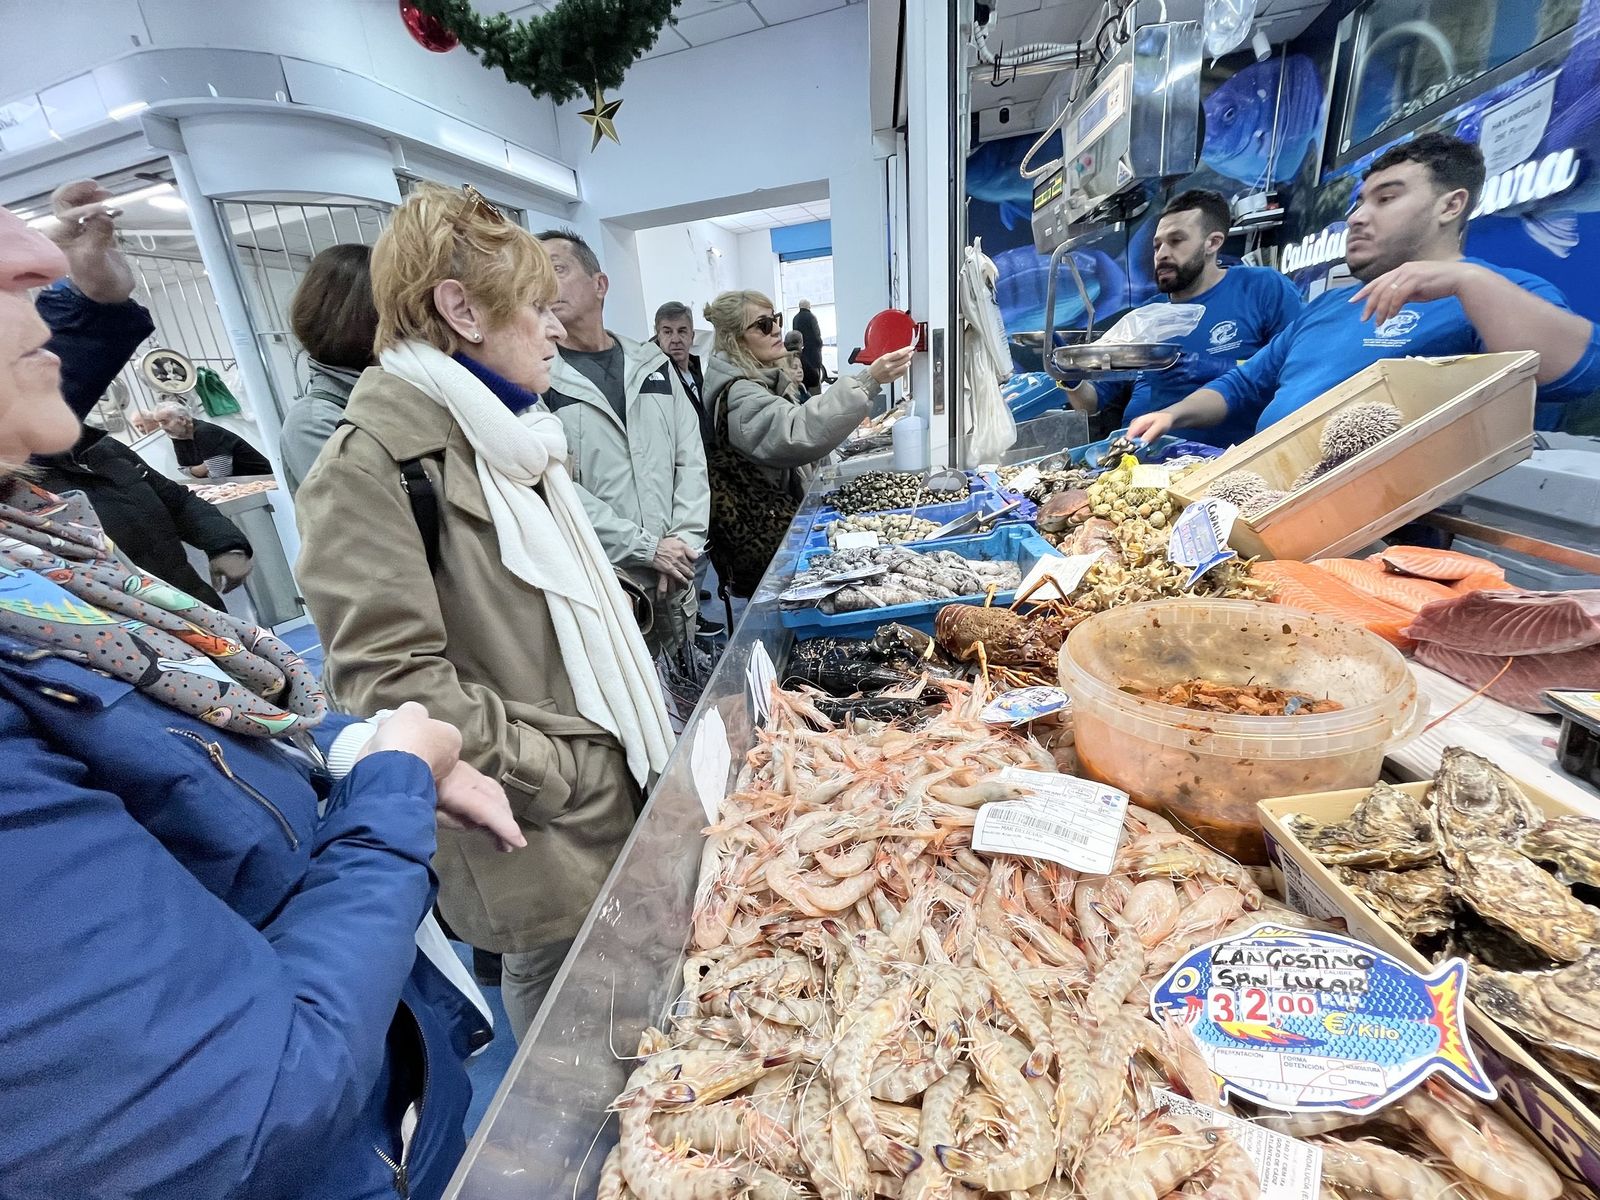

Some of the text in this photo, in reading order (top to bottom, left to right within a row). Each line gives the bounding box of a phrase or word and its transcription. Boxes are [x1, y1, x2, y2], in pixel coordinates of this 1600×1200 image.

[1467, 148, 1580, 221] ura
[1212, 944, 1374, 971] LANGOSTINO
[1217, 968, 1369, 993] SAN LUCAR
[1321, 1012, 1400, 1040] €/Kilo
[1348, 1079, 1380, 1088] EXTRACTIVA
